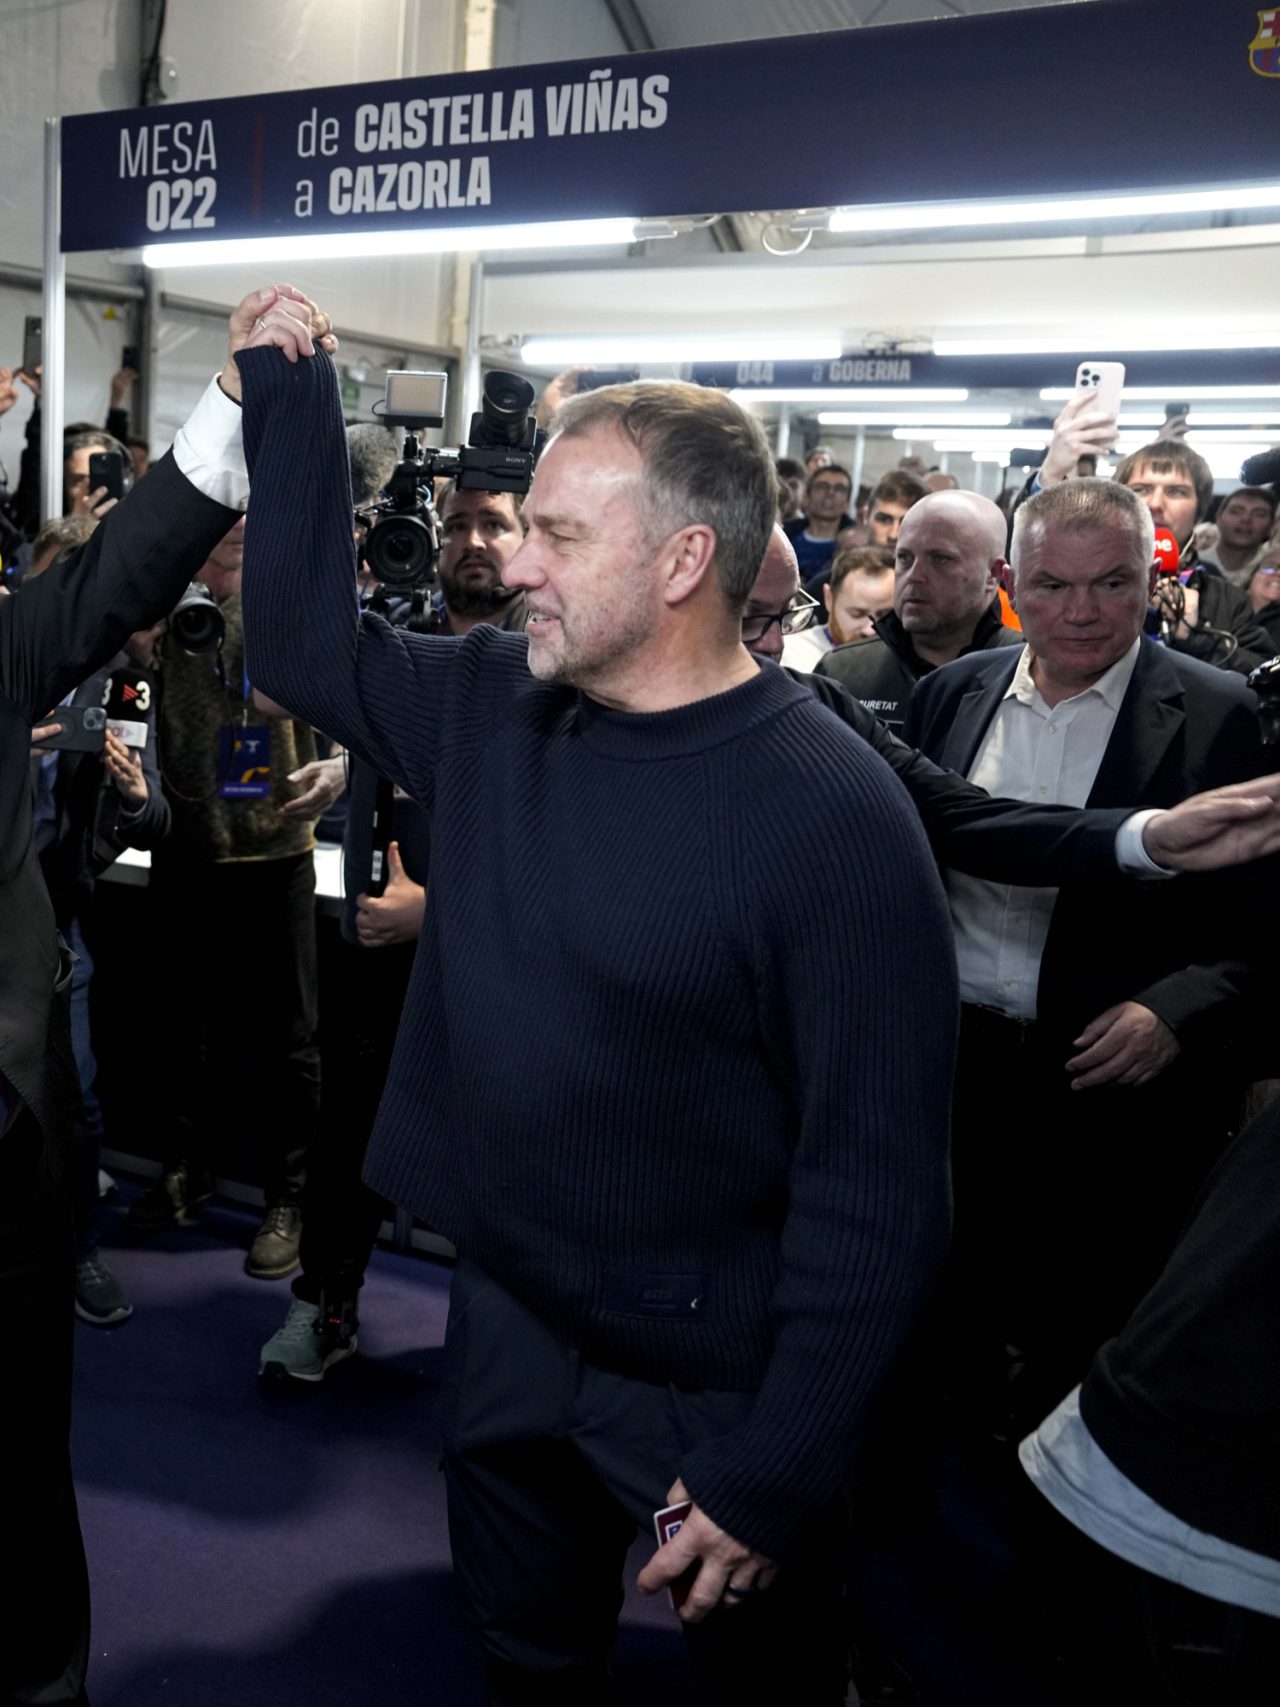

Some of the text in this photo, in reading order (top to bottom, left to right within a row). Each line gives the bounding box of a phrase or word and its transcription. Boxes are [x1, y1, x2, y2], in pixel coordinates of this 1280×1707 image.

[296, 70, 670, 157] de CASTELLA VIÑAS
[120, 119, 218, 179] MESA
[146, 177, 217, 231] 022
[294, 156, 491, 217] a CAZORLA
[736, 361, 775, 385] 044
[828, 358, 912, 383] GOBERNA
[135, 680, 151, 711] 3
[859, 699, 899, 711] URETAT
